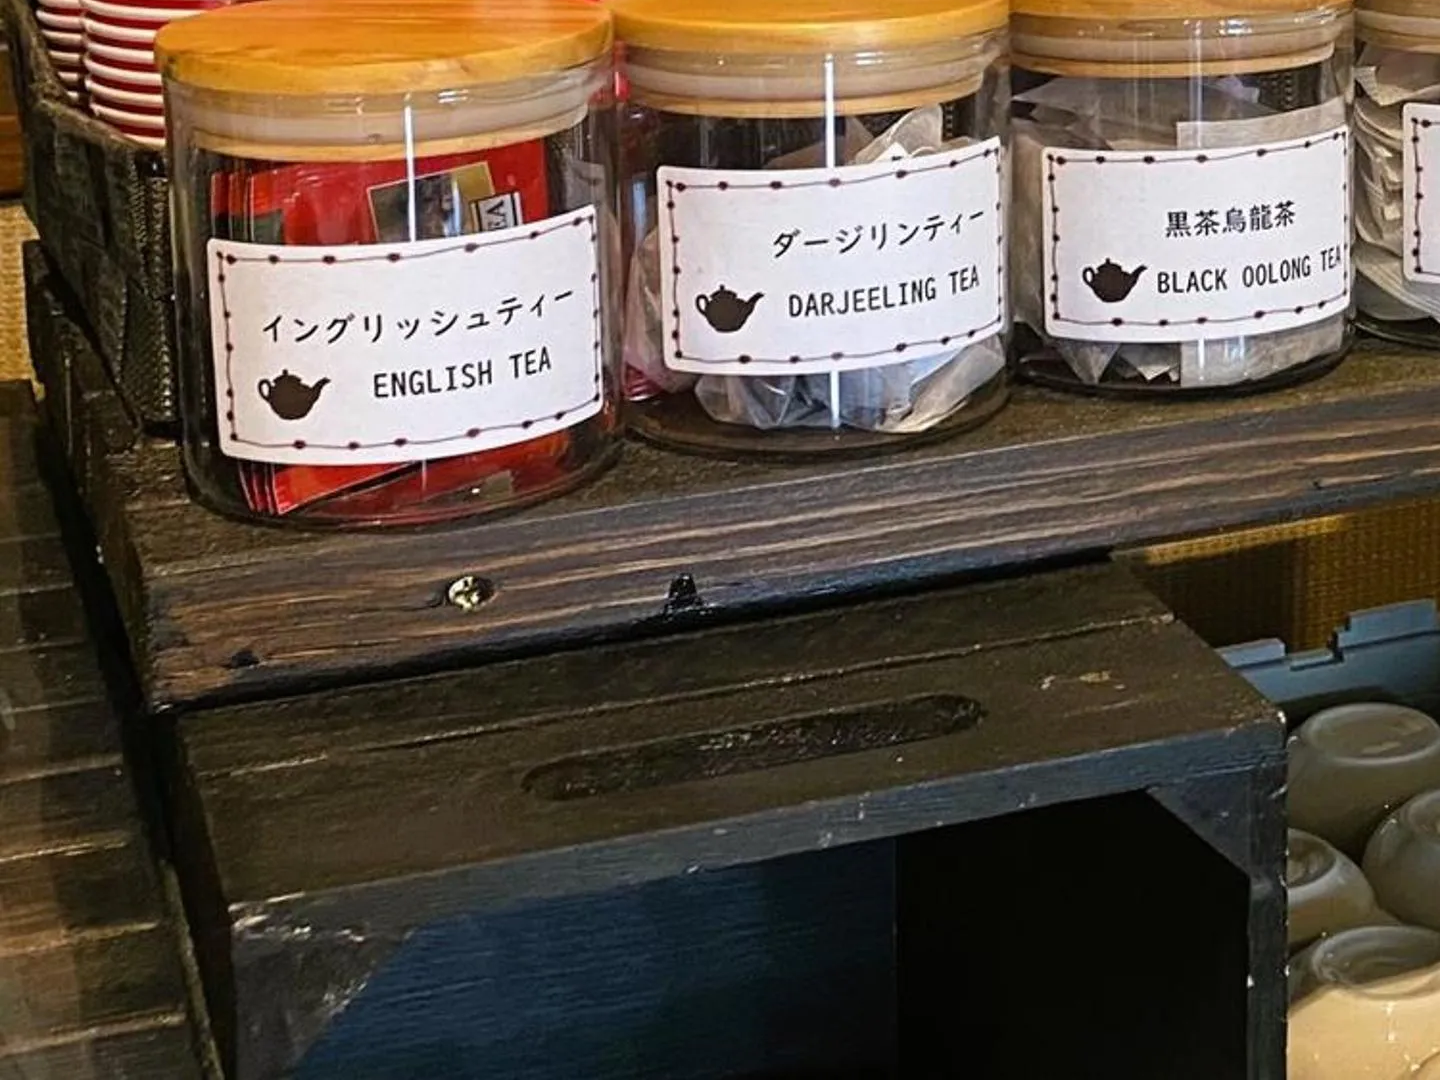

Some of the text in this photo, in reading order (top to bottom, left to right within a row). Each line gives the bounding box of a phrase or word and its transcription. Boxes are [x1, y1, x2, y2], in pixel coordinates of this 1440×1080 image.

[773, 210, 985, 258] ダージリンティー
[1165, 200, 1297, 238] 黒茶烏龍茶
[788, 264, 981, 318] DARJEELING TEA
[1157, 245, 1342, 295] BLACK OOLONG TEA
[262, 290, 574, 345] イングリッシュティー
[373, 346, 552, 399] ENGLISH TEA
